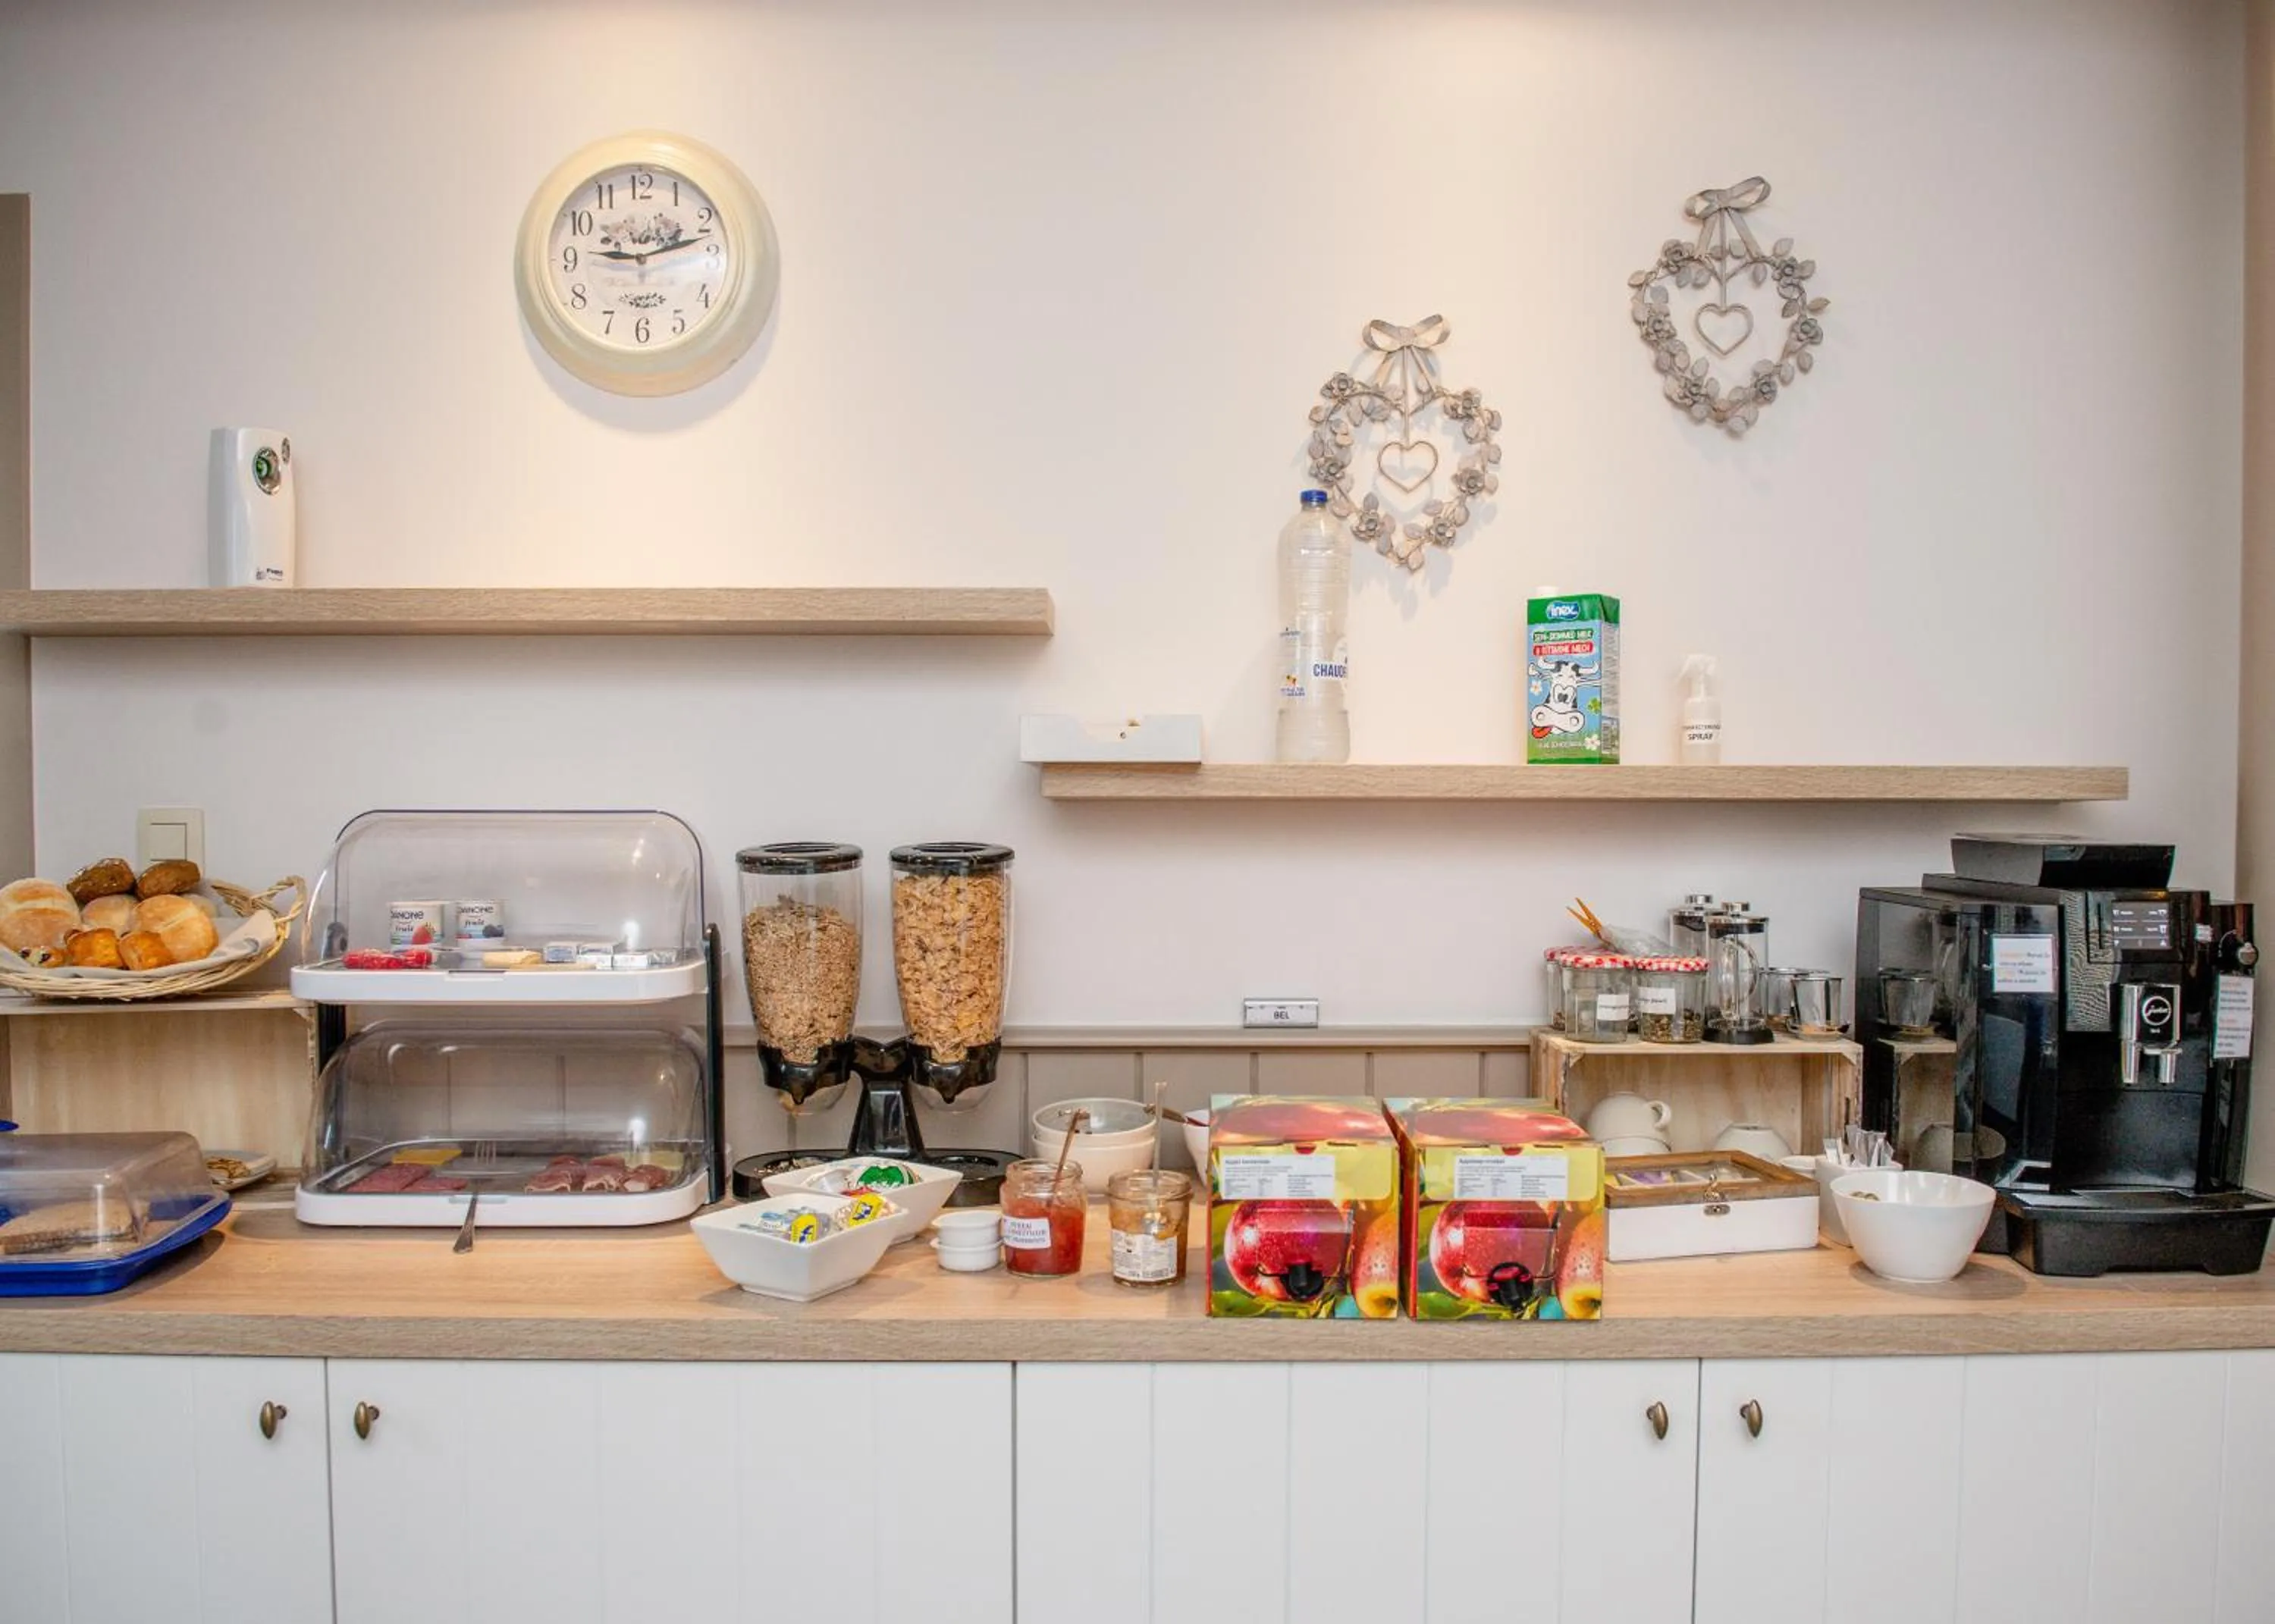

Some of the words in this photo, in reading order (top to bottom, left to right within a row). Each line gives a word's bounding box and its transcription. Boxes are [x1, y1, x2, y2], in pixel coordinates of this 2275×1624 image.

[597, 183, 613, 210] 11
[630, 173, 653, 200] 12
[672, 181, 679, 206] 1
[571, 210, 593, 237] 10
[697, 207, 712, 233] 2
[563, 246, 578, 273] 9
[705, 244, 720, 269] 3
[571, 283, 587, 309] 8
[696, 283, 710, 309] 4
[601, 309, 615, 334] 7
[634, 317, 650, 343] 6
[672, 309, 685, 334] 5
